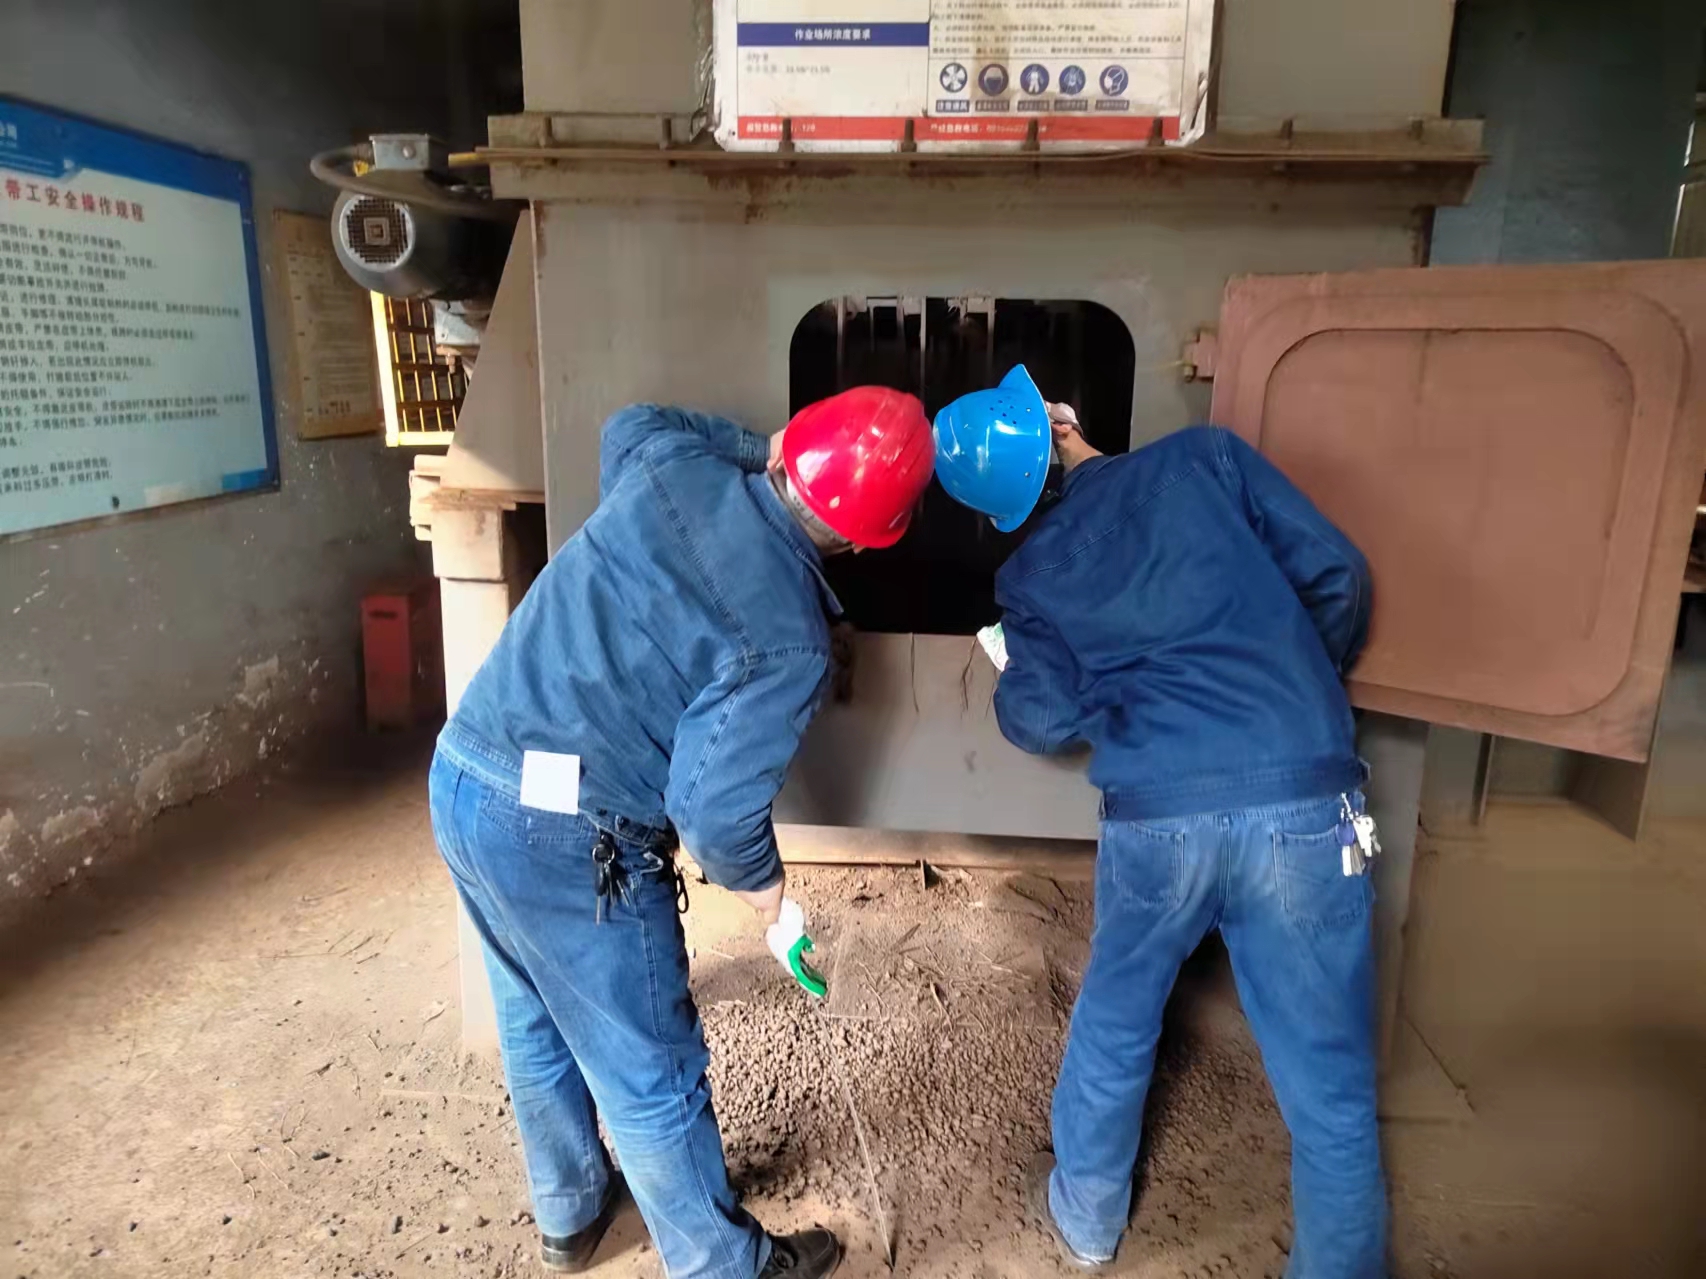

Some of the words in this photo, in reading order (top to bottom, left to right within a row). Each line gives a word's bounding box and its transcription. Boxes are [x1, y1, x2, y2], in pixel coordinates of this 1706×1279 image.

[794, 28, 872, 41] 作业场所浓度要求
